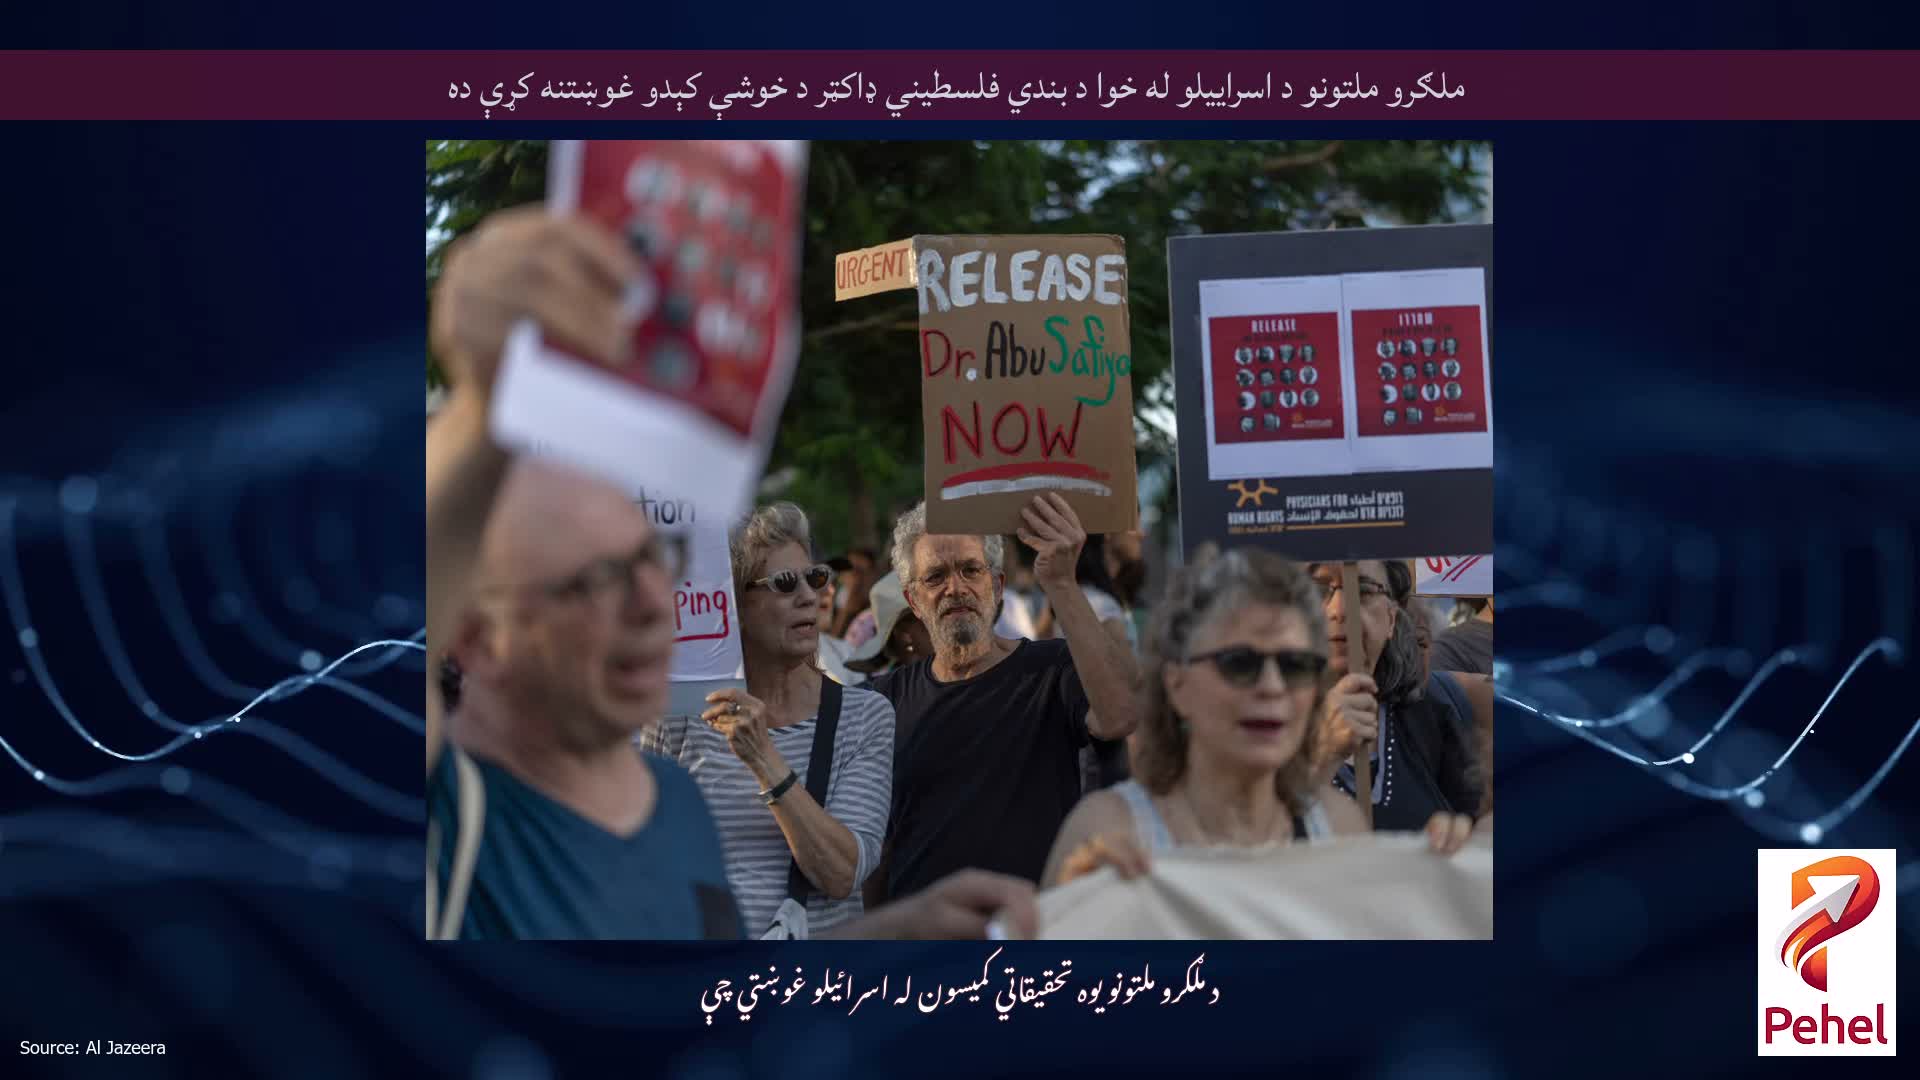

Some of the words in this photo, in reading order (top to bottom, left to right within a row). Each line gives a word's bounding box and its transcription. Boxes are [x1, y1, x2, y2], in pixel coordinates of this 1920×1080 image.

[836, 247, 909, 290] URGENT
[918, 248, 1127, 314] RELEASE
[921, 329, 977, 381] Dr.
[985, 320, 1045, 379] Abu
[1251, 318, 1297, 334] RELEASE
[941, 400, 1082, 465] NOW
